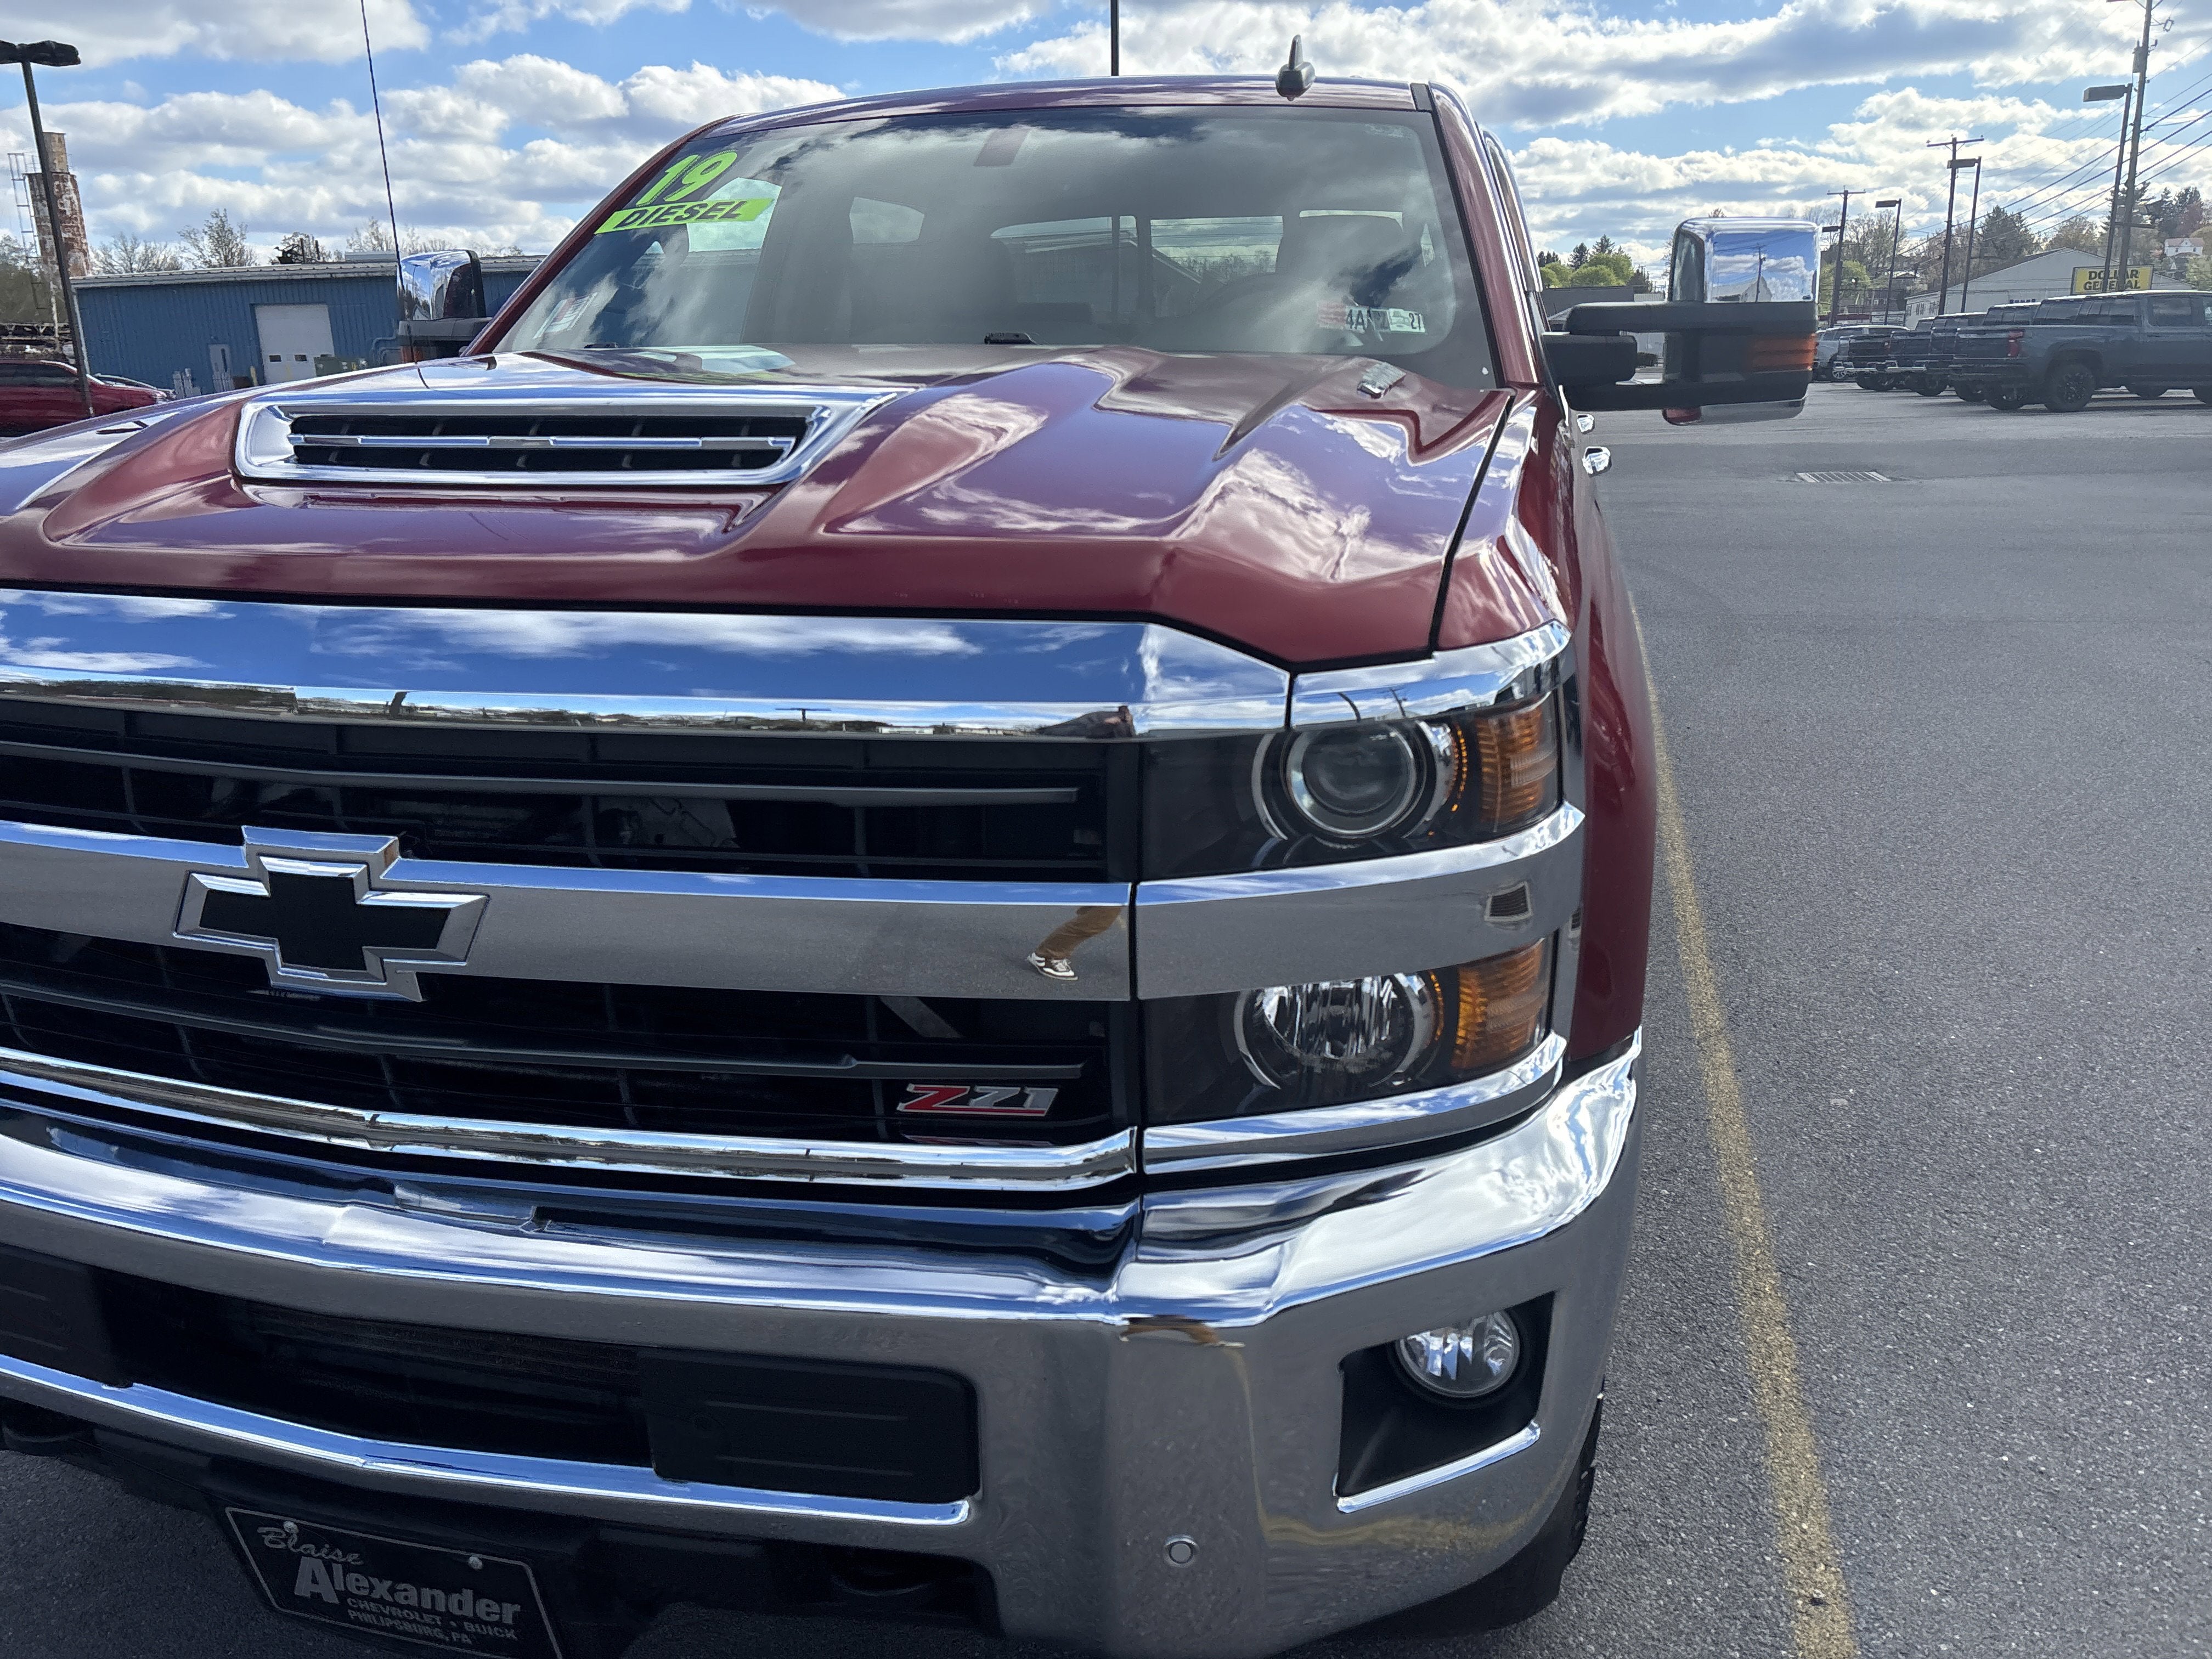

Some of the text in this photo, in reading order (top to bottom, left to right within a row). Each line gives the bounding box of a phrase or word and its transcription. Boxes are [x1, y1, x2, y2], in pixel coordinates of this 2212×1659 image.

[636, 150, 737, 207] 19
[613, 200, 748, 229] DIESEL
[2083, 279, 2141, 291] GEEAL
[896, 1083, 1059, 1116] Z71
[257, 1526, 364, 1566] Blaise
[294, 1556, 521, 1625] Alexander
[347, 1597, 518, 1641] CHEVROLET BUICK
[452, 1631, 473, 1645] PA
